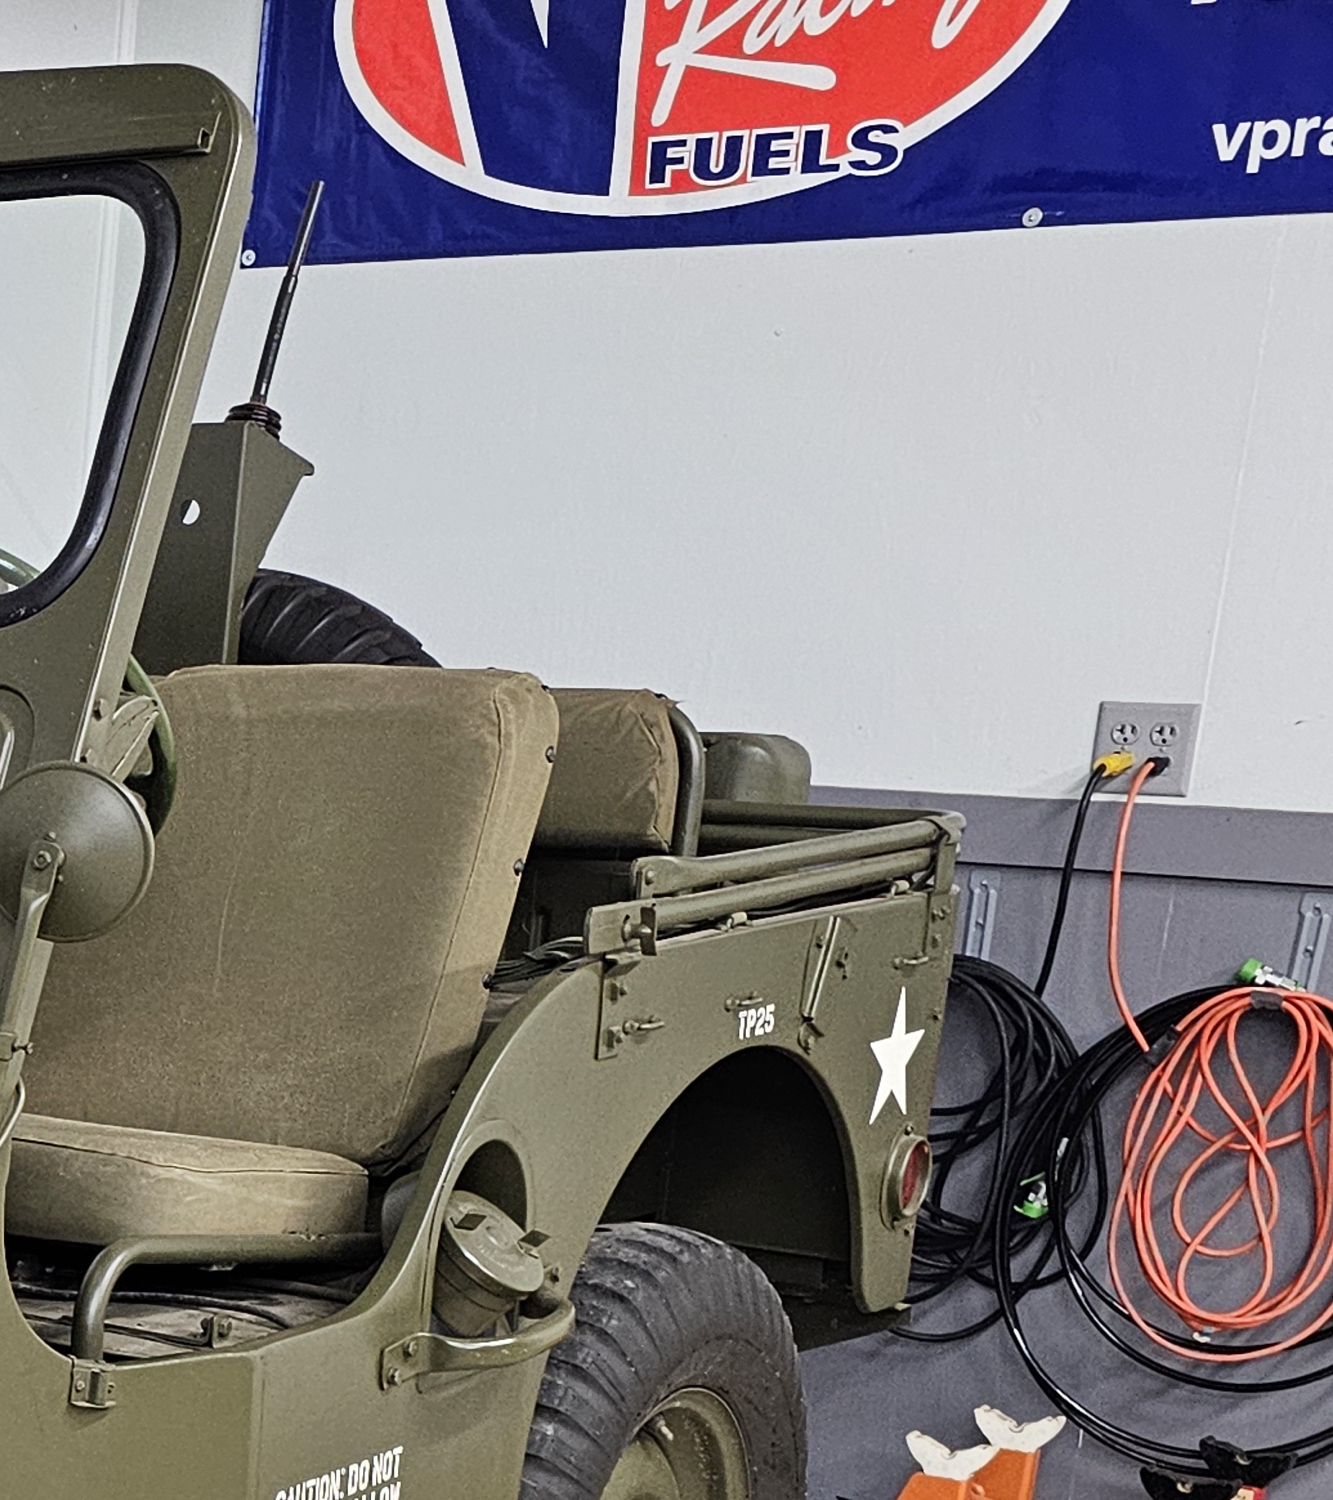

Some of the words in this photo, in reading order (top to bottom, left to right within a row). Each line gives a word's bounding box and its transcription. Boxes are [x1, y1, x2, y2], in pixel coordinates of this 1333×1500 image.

[646, 122, 903, 187] FUELS
[738, 1003, 775, 1040] TP25
[347, 1459, 371, 1496] DO
[372, 1445, 404, 1486] NOT
